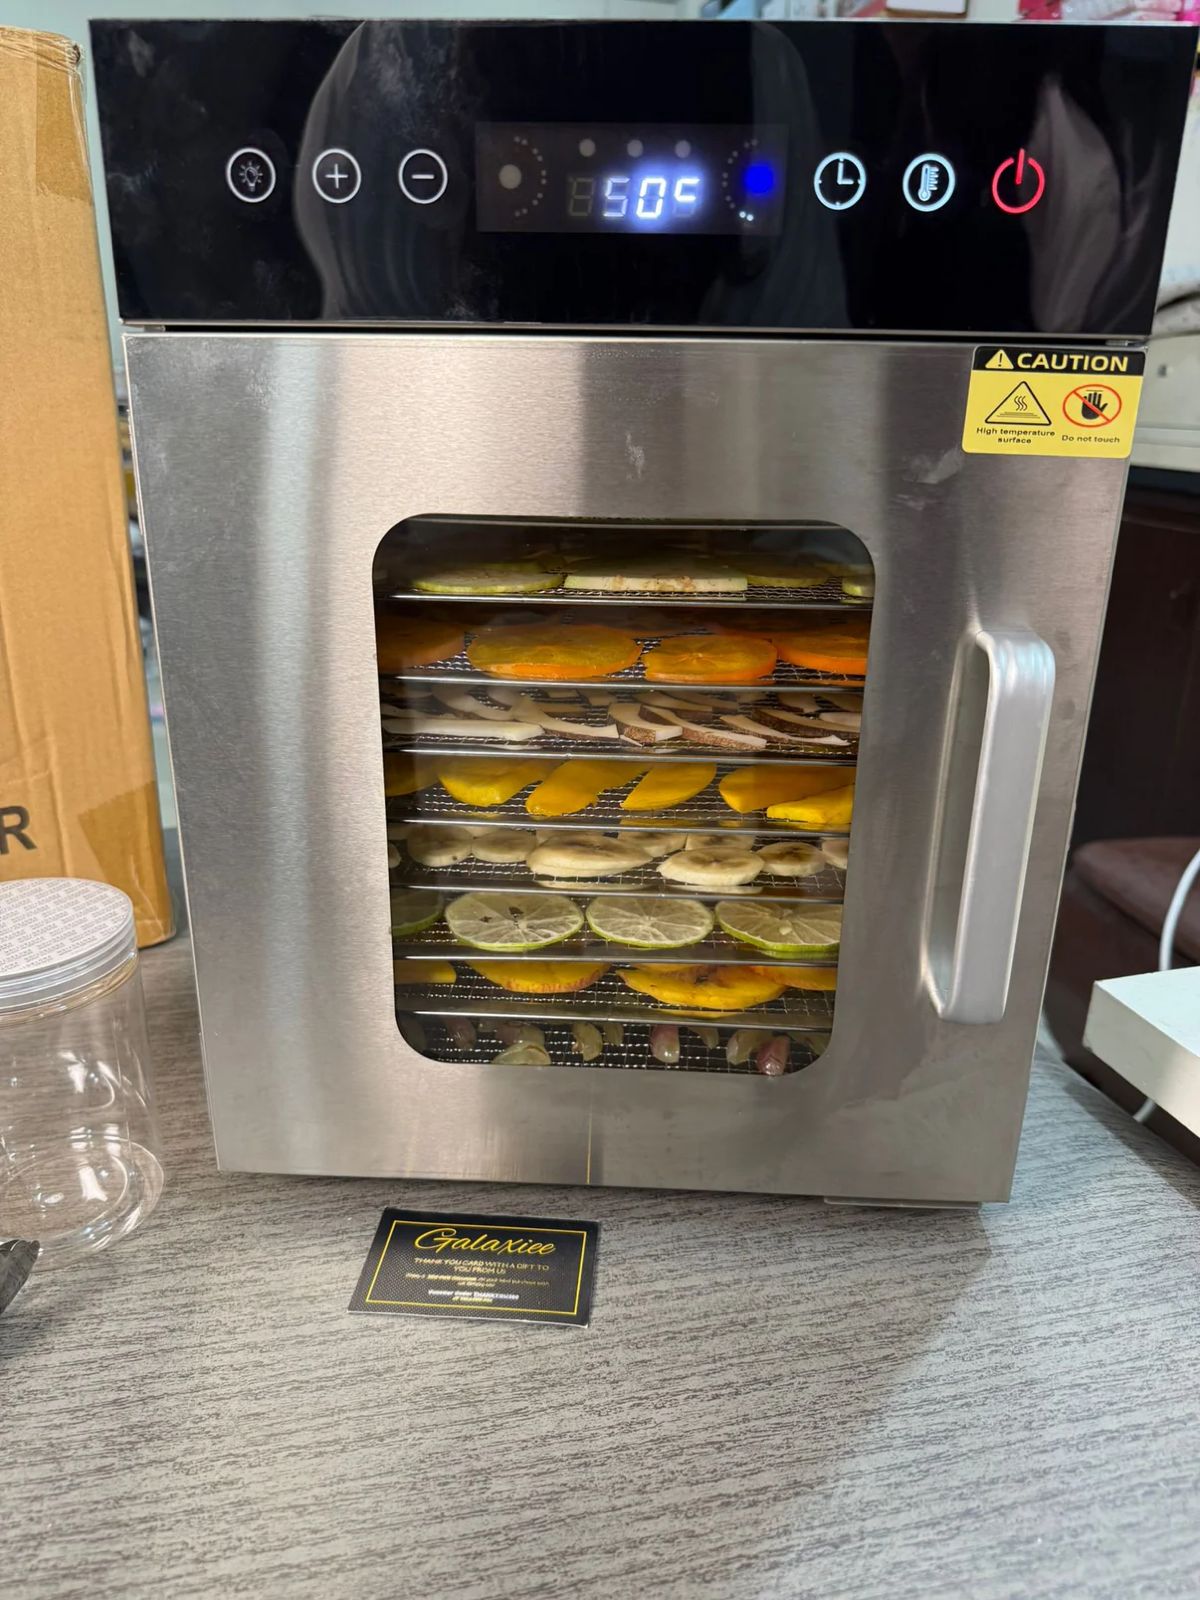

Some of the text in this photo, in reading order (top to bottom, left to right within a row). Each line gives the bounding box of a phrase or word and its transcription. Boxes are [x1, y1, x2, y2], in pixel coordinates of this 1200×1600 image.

[1016, 352, 1129, 372] CAUTION
[976, 427, 1056, 437] High temperature
[997, 436, 1032, 444] surface
[1061, 434, 1075, 442] Do
[414, 1228, 556, 1255] Galaxiee
[414, 1257, 443, 1265] THANK
